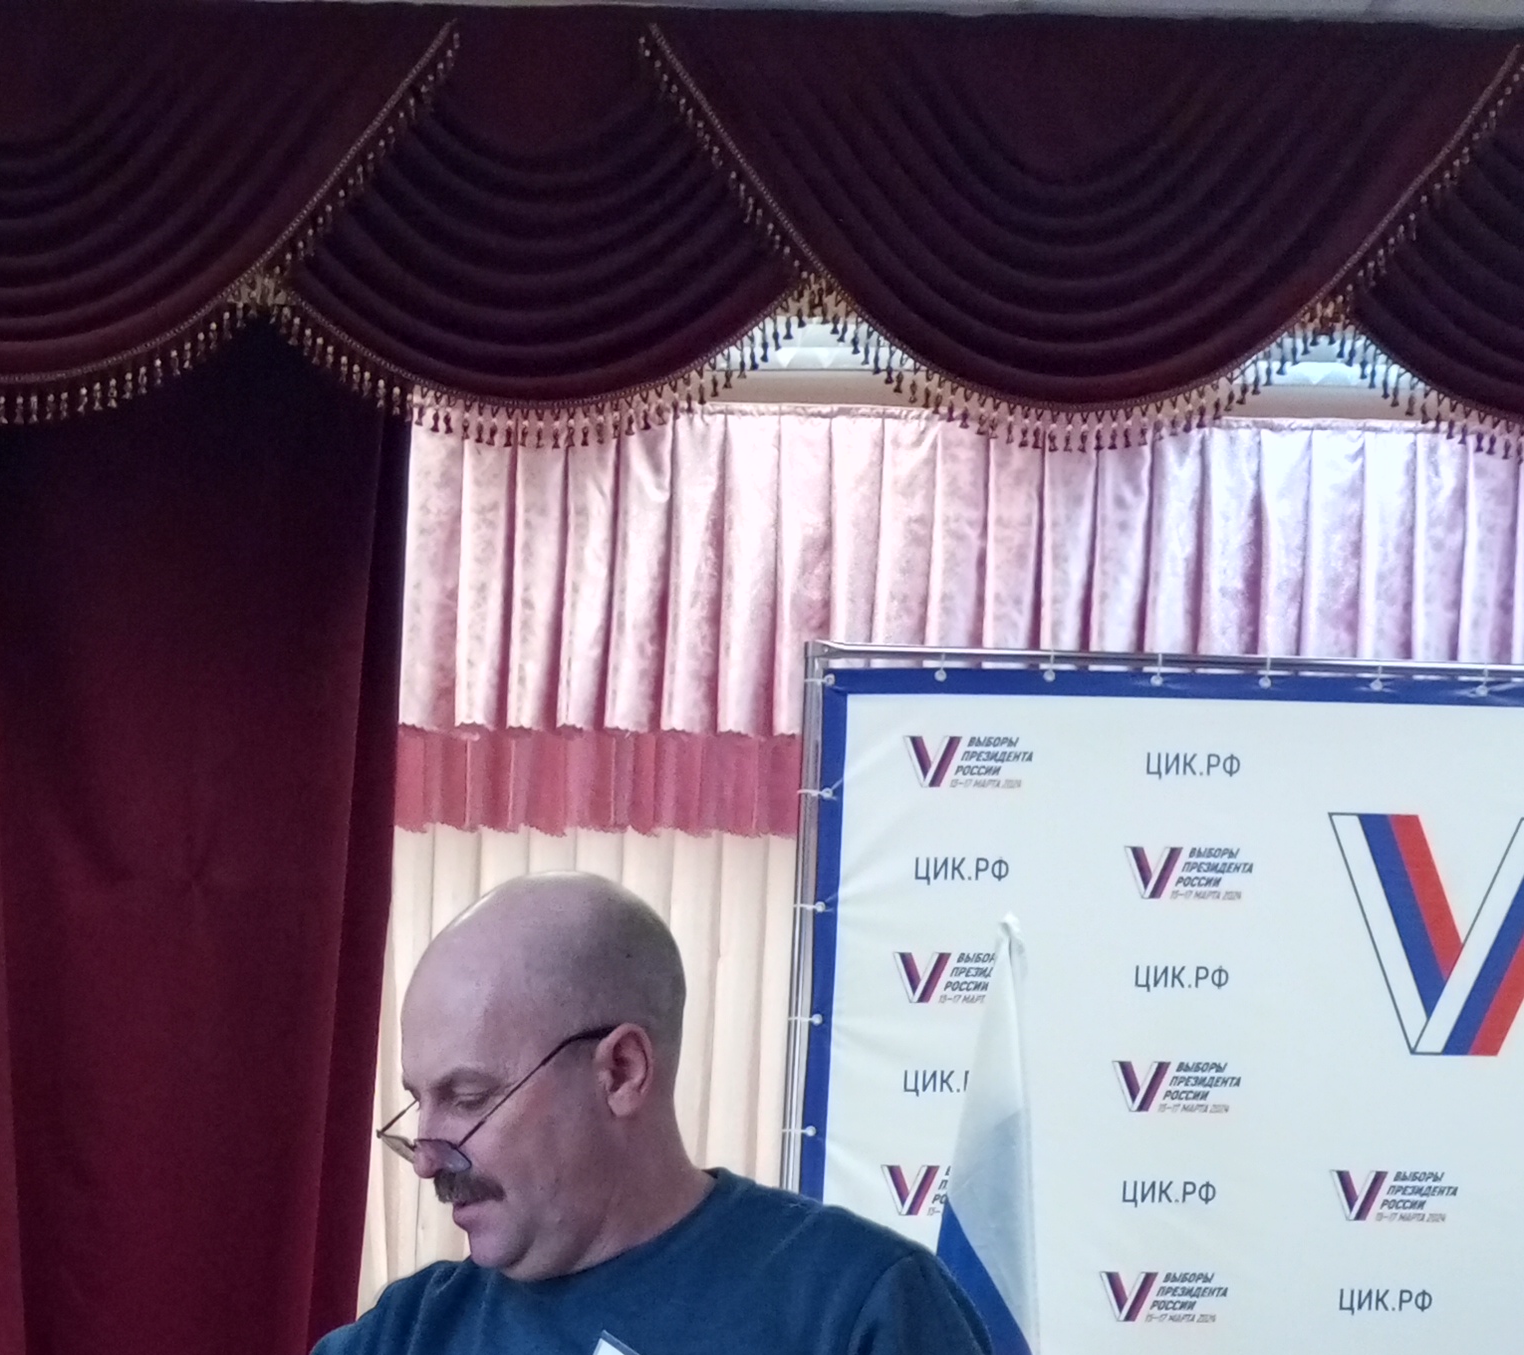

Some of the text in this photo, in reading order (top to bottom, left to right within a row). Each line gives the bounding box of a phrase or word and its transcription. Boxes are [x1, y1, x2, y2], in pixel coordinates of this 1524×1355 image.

[967, 736, 1019, 748] ВЫБОРЫ
[961, 750, 1034, 763] ПРЕЗИДЕНТА
[954, 765, 1002, 776] РОССИИ
[1145, 751, 1241, 779] ЦИК.РФ
[1188, 847, 1240, 859] ВЫБОРЫ
[914, 856, 1010, 884] ЦИК.РФ
[1181, 861, 1254, 874] ПРЕЗИДЕНТА
[1174, 876, 1222, 888] РОССИИ
[956, 952, 996, 964] ВЫБО
[950, 966, 994, 979] ПРЕЗИ
[1134, 964, 1230, 993] ЦИК.РФ
[962, 994, 986, 1003] МАРТ
[1175, 1061, 1228, 1073] ВЫБОРЫ
[903, 1070, 969, 1097] ЦИК.
[1169, 1076, 1242, 1088] ПРЕЗИДЕНТА
[1162, 1090, 1210, 1101] РОССИИ
[1393, 1171, 1445, 1182] ВЫБОРЫ
[1122, 1179, 1217, 1207] ЦИК.РФ
[1386, 1185, 1459, 1197] ПРЕЗИДЕНТА
[1380, 1199, 1427, 1210] РОССИИ
[1162, 1272, 1215, 1283] ВЫБОРЫ
[1156, 1286, 1228, 1298] ПРЕЗИДЕНТА
[1149, 1300, 1197, 1311] РОССИИ
[1338, 1288, 1433, 1315] ЦИК.РФ
